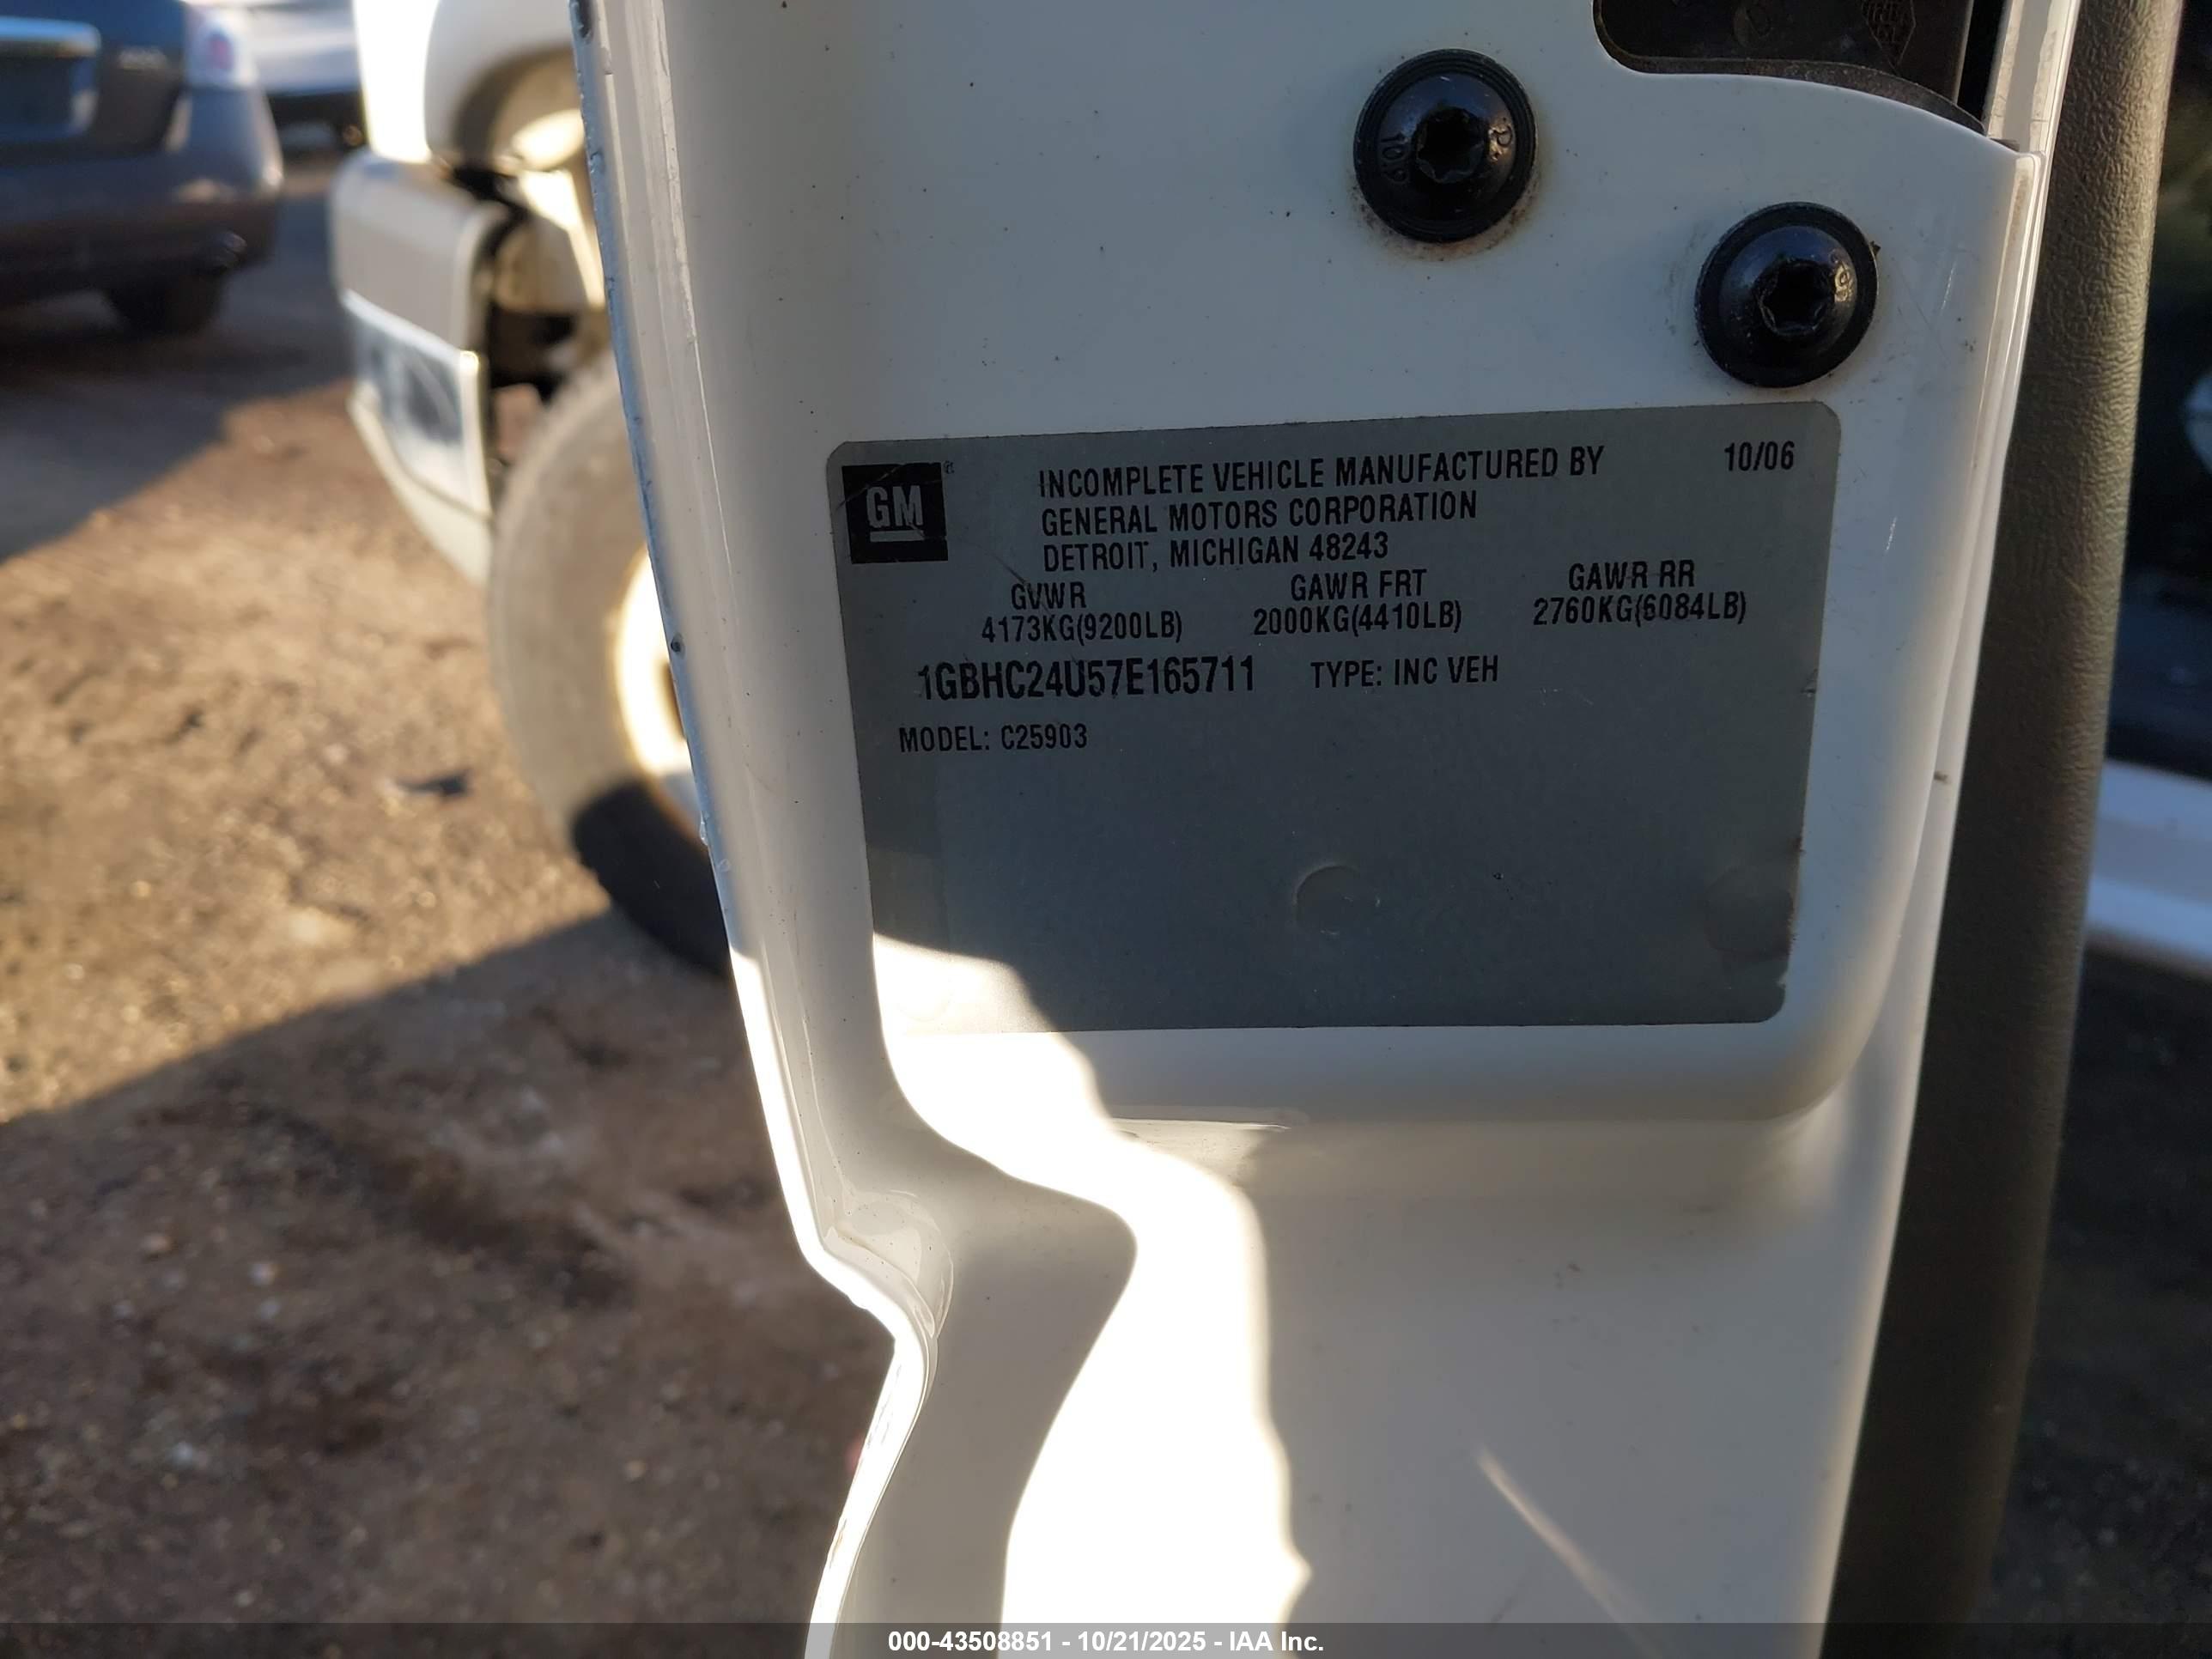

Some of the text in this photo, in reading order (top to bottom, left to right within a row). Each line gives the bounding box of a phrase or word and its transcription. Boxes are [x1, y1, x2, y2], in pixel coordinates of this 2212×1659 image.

[1040, 446, 1604, 498] INCOMPLETE VEHICLE MANUFACTURED BY
[1724, 441, 1795, 471] 10/06
[866, 484, 924, 529] GM
[1042, 490, 1476, 536] GENERAL MOTORS CORPORATION
[1043, 531, 1388, 573] DETROIT, MICHIGAN 48243
[1291, 569, 1426, 601] GAWR FRT
[1569, 560, 1694, 591] GAWR RR
[1012, 582, 1087, 610] GVWR
[1534, 590, 1747, 628] 2760KG(6084LB)
[982, 611, 1182, 646] 4173KG(9200LB)
[1254, 599, 1462, 637] 2000KG(4410LB)
[918, 656, 1254, 701] 1GBHC24U57E165711
[1310, 655, 1498, 688] TYPE: INC VEH
[898, 723, 1086, 753] MODEL: C25903
